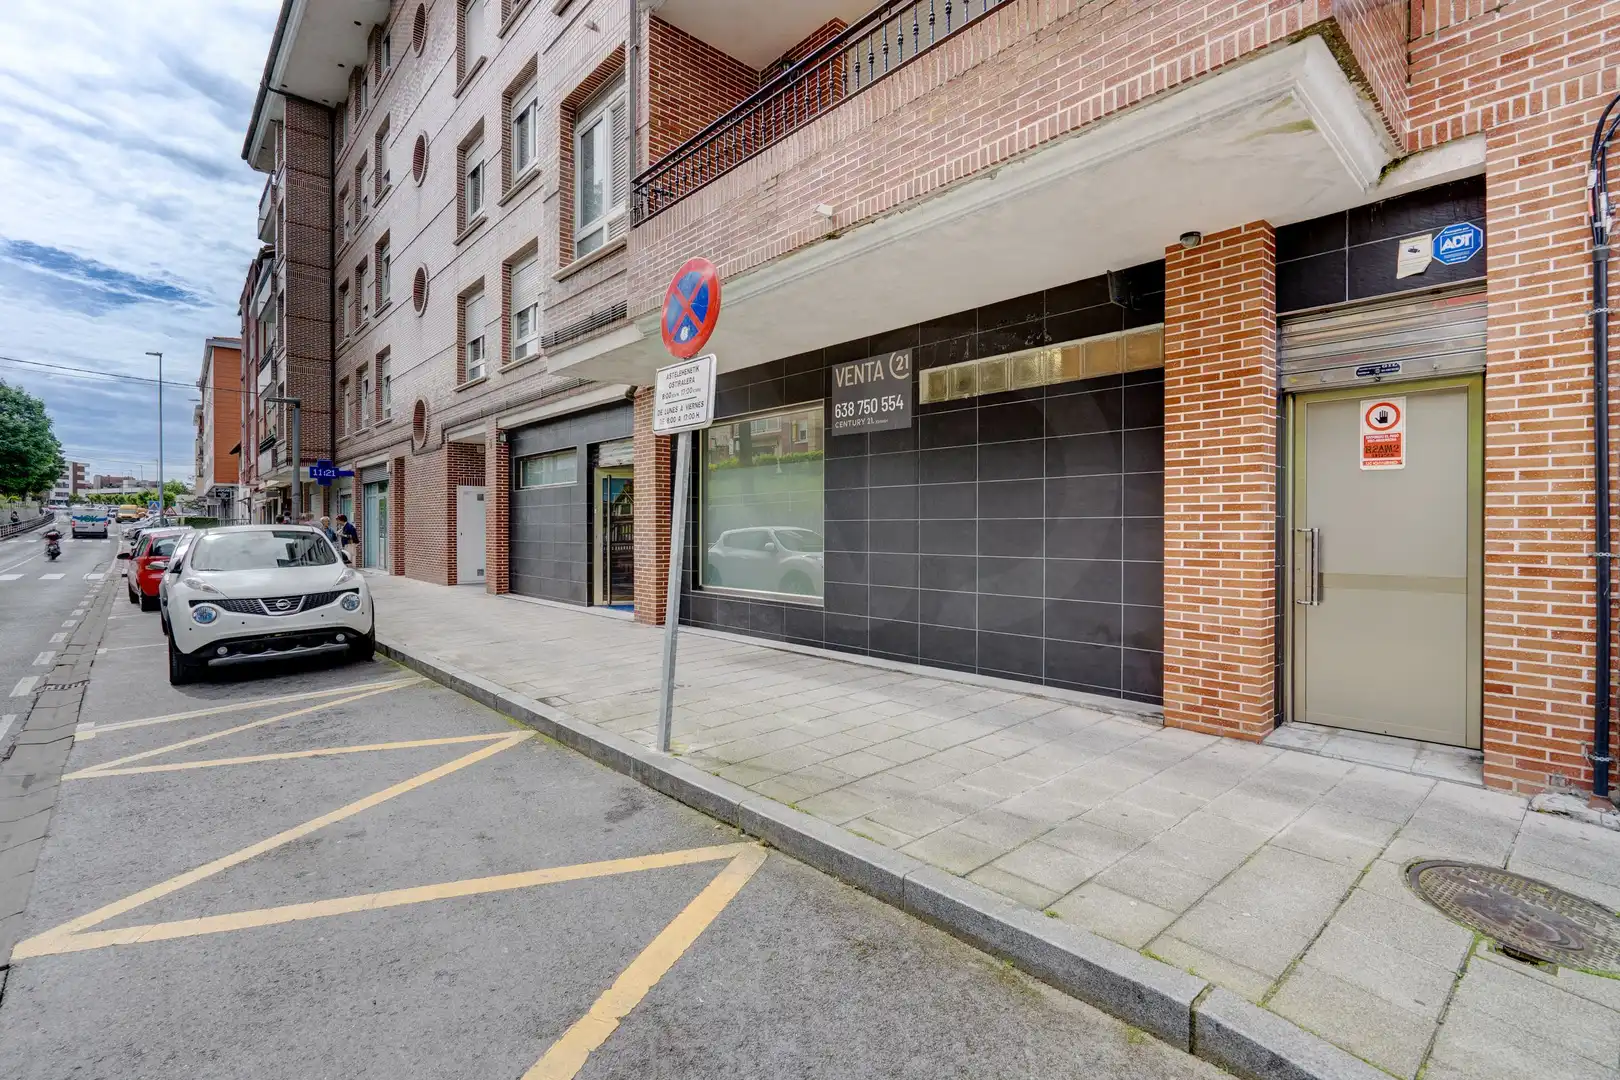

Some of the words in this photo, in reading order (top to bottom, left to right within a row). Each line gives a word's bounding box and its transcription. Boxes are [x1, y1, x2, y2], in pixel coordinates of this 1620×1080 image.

[1440, 233, 1473, 251] ADT
[835, 360, 885, 388] VENTA
[664, 406, 678, 415] LUNES
[685, 401, 705, 411] VIERNES
[834, 401, 855, 419] 638
[857, 397, 878, 416] 750
[881, 394, 904, 412] 554
[834, 418, 866, 429] CENTURY
[312, 469, 336, 477] 11:21
